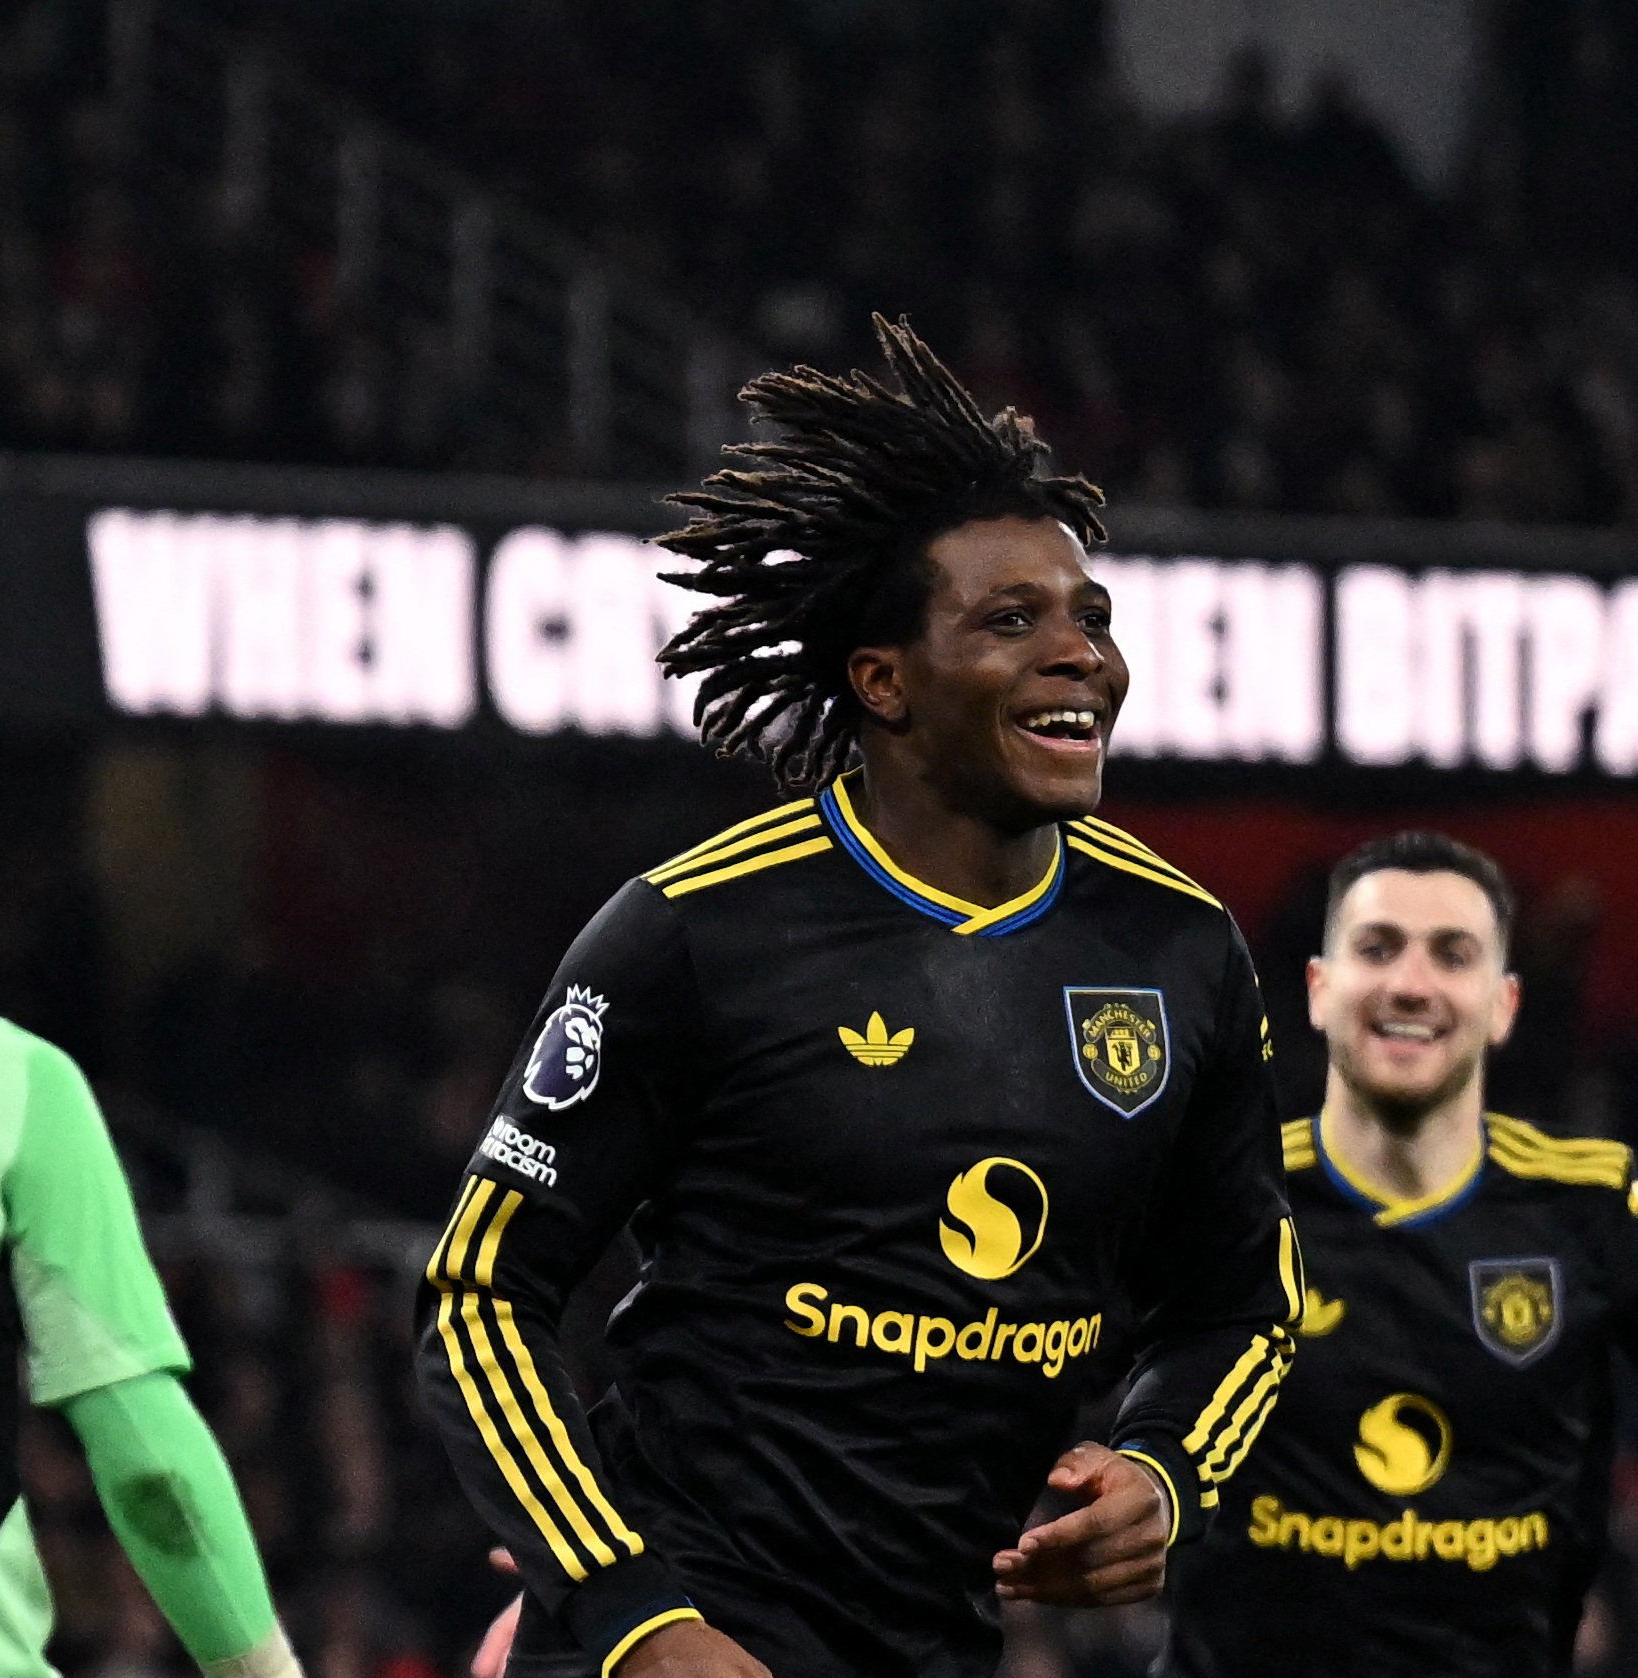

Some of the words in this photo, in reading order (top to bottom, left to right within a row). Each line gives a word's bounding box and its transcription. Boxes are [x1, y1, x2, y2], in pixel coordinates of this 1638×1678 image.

[84, 508, 474, 729] WHEN
[1089, 556, 1325, 763] HEN
[1088, 1009, 1152, 1039] MANCHESTER
[1104, 1071, 1148, 1087] UNITED
[784, 1282, 1102, 1379] Snapdragon
[1248, 1494, 1549, 1571] Snapdragon
